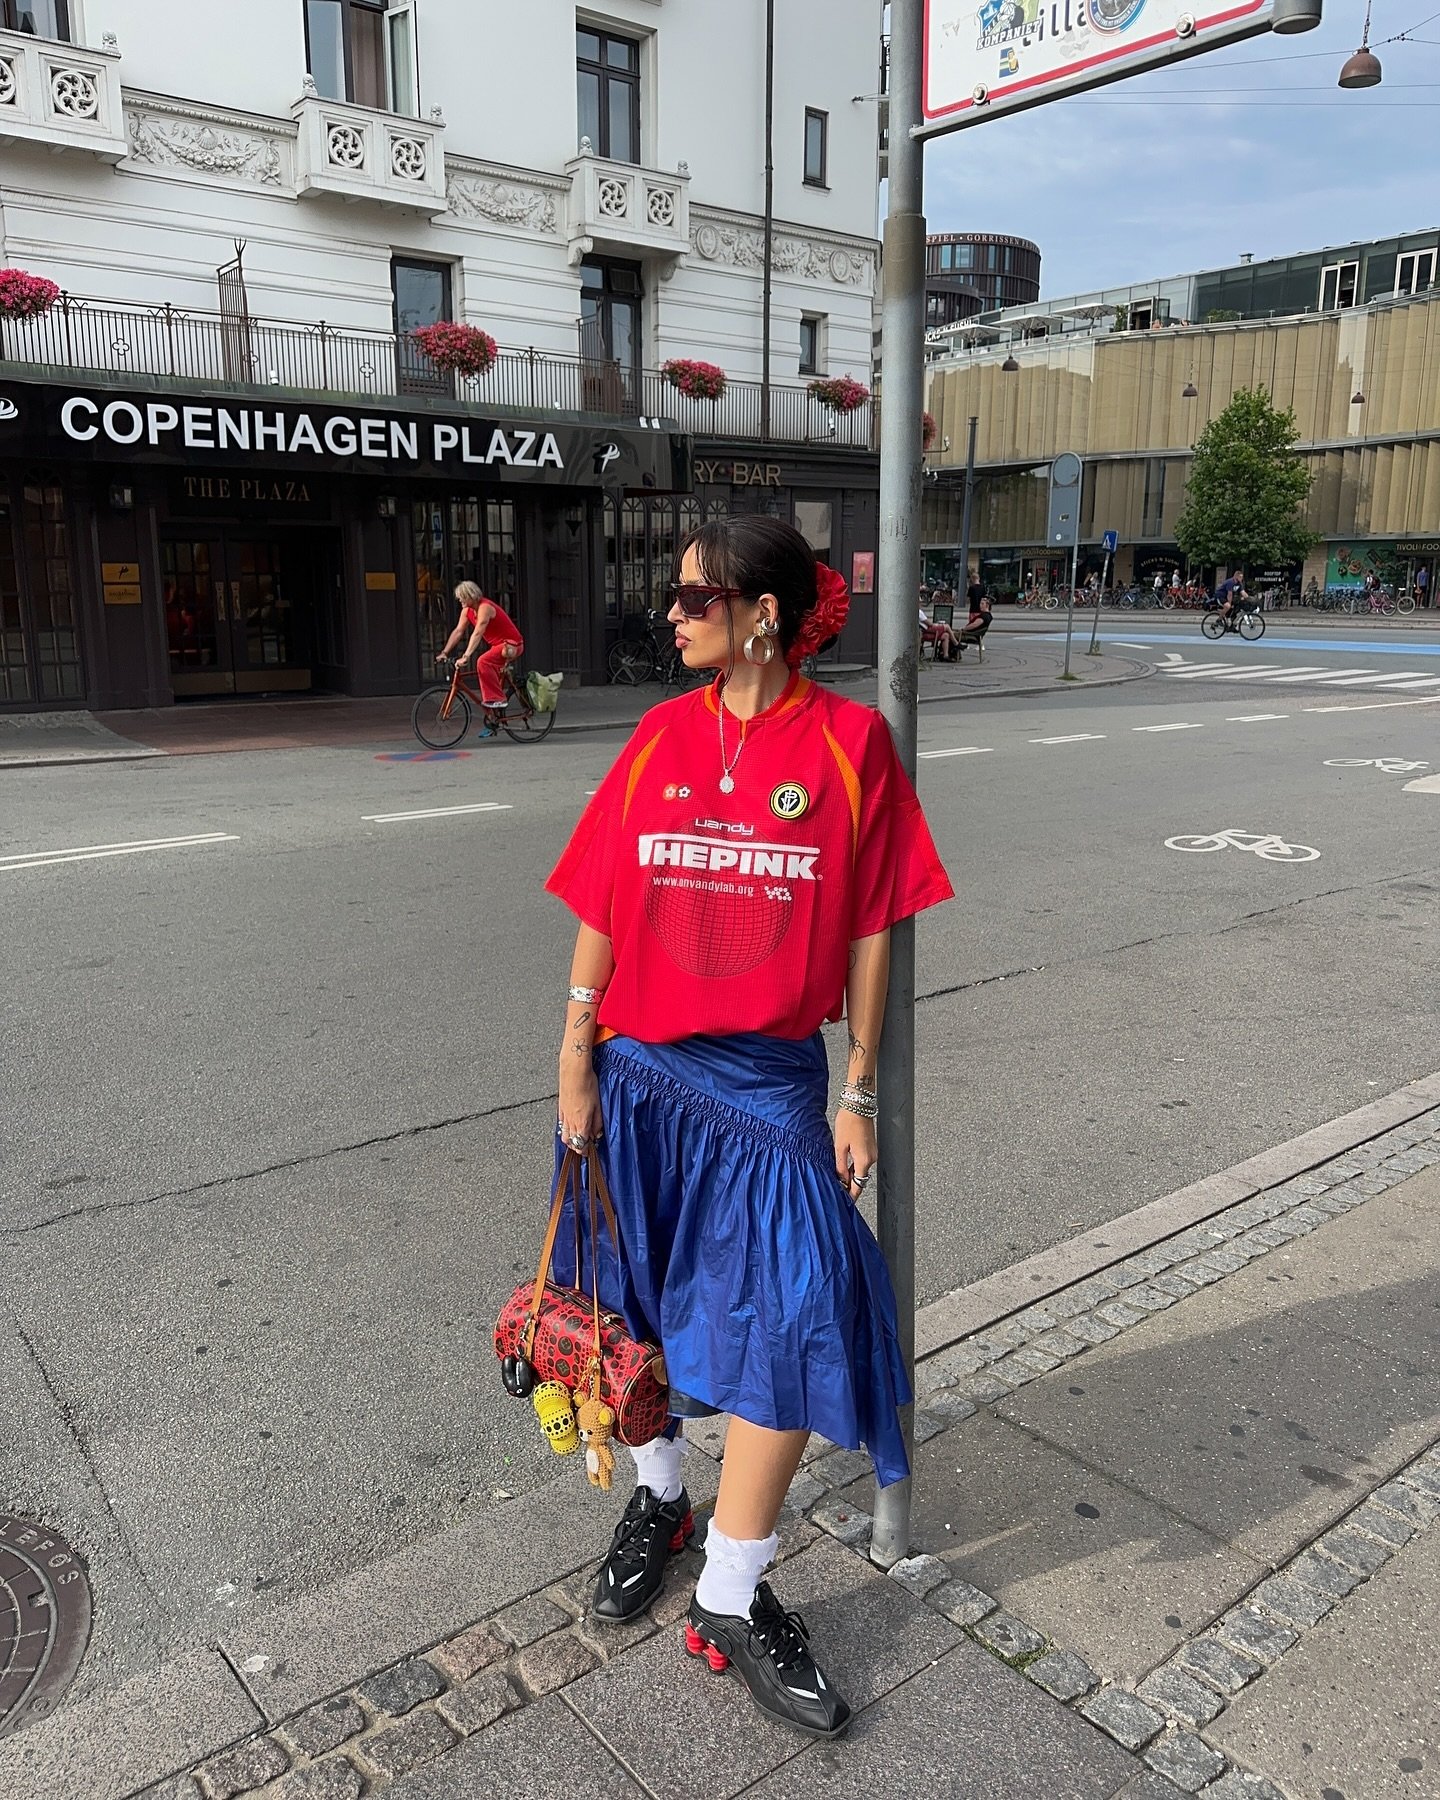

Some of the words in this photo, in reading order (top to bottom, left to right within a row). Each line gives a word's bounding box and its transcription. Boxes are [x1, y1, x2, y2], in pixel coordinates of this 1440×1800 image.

[976, 20, 1040, 50] KOMPANIET
[966, 234, 1020, 245] GORRISSEN
[61, 397, 418, 460] COPENHAGEN
[434, 424, 564, 469] PLAZA
[694, 460, 720, 483] RY
[732, 462, 781, 486] BAR
[184, 476, 231, 498] THE
[240, 480, 310, 501] PLAZA
[1396, 543, 1418, 551] TIVOLI
